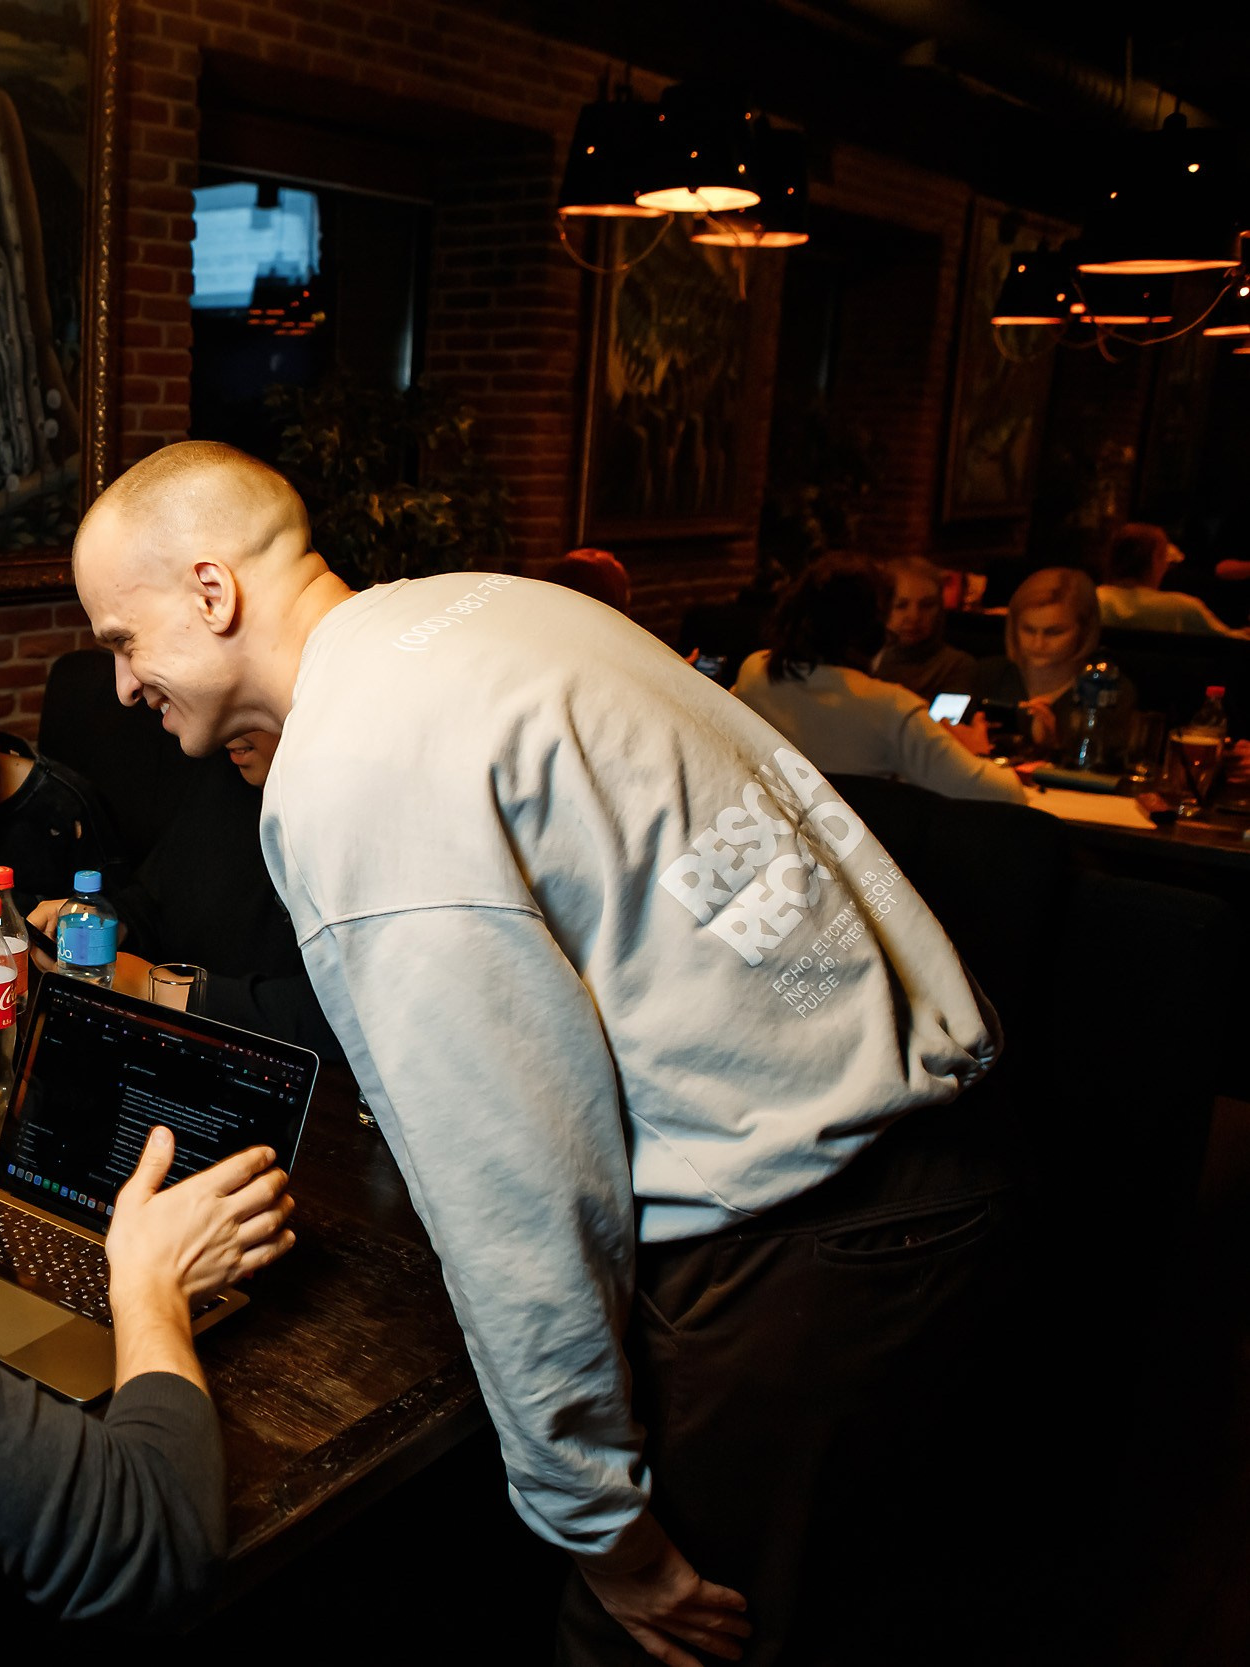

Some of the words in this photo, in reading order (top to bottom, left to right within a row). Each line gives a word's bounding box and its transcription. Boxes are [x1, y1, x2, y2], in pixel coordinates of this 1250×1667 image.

[445, 574, 517, 615] 987-76
[772, 956, 813, 995] ECHO
[783, 980, 815, 1007] INC.
[818, 956, 841, 976] 49,
[837, 919, 867, 952] FREQ
[795, 974, 840, 1019] PULSE
